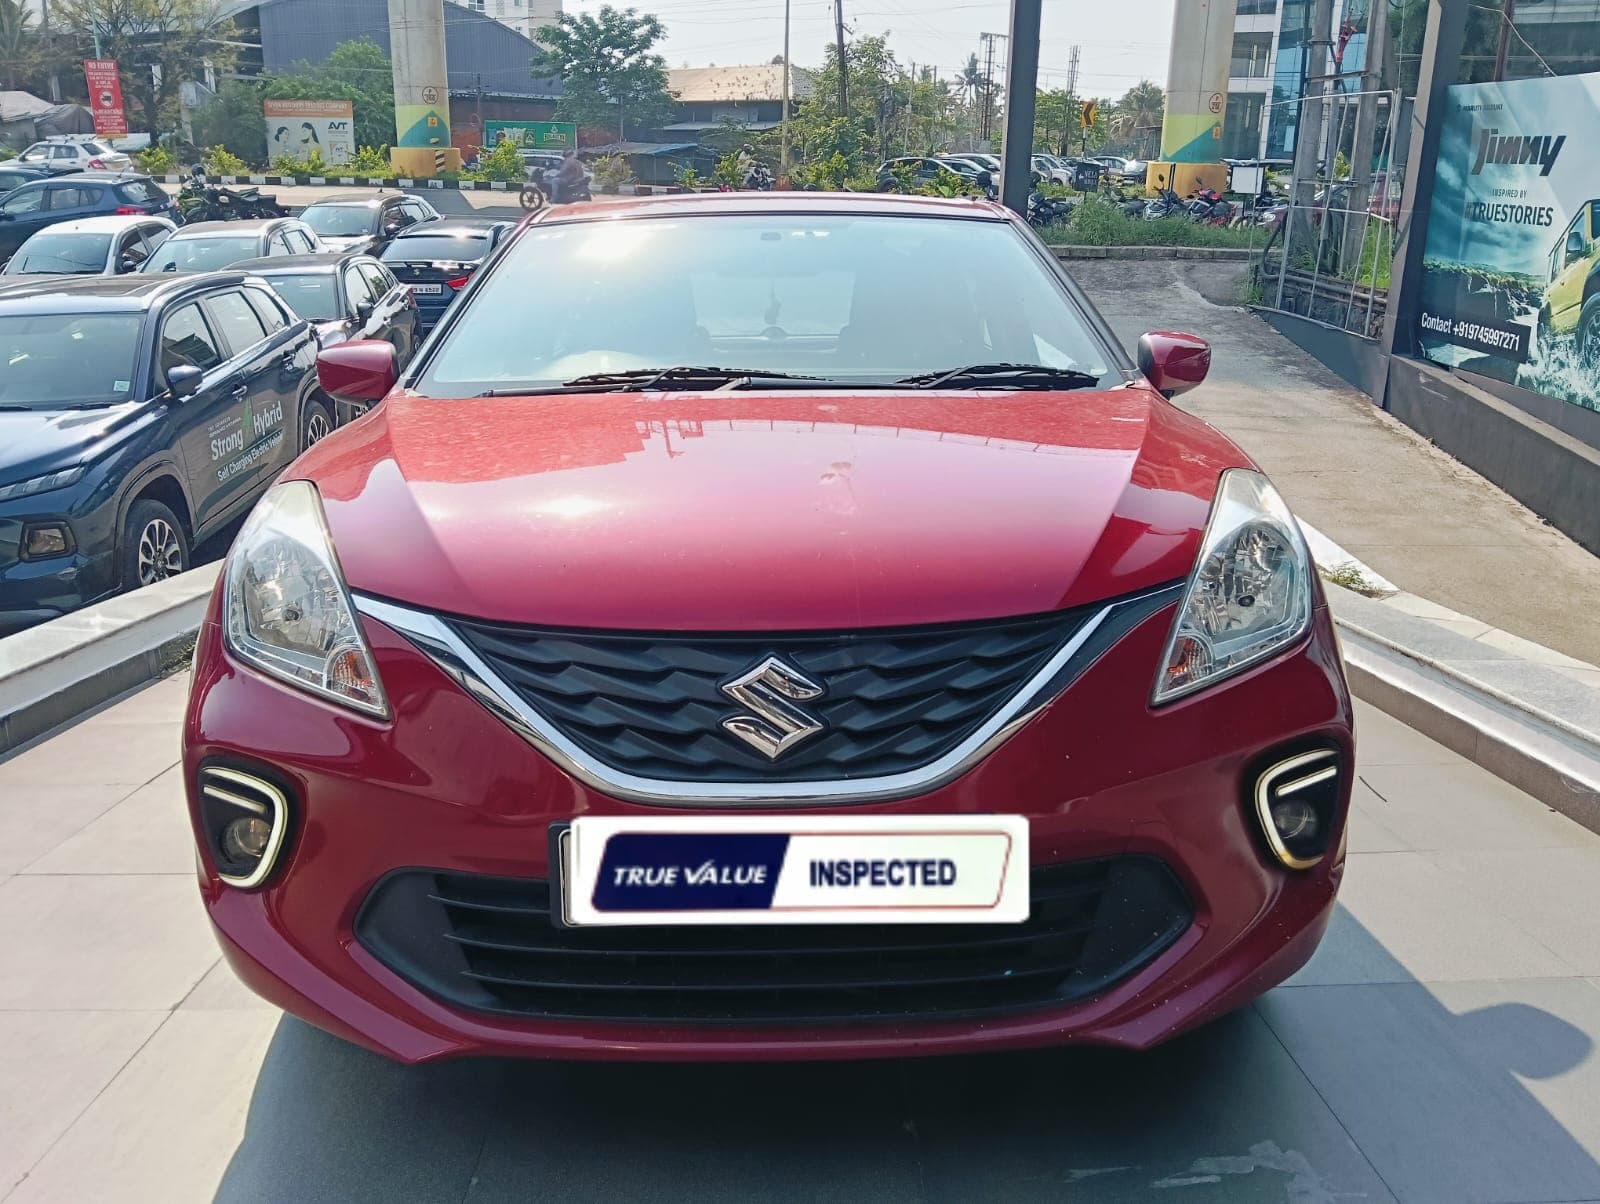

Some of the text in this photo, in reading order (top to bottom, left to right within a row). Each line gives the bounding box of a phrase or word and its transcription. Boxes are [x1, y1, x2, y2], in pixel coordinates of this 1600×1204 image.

[328, 121, 348, 130] AVT
[1471, 128, 1567, 176] Jimny
[1492, 188, 1527, 198] INSPIRED BY
[1421, 312, 1520, 351] Contact +919745997271
[211, 429, 244, 461] Strong
[253, 401, 283, 436] Hybrid
[217, 465, 230, 481] Self
[229, 452, 253, 474] Charging
